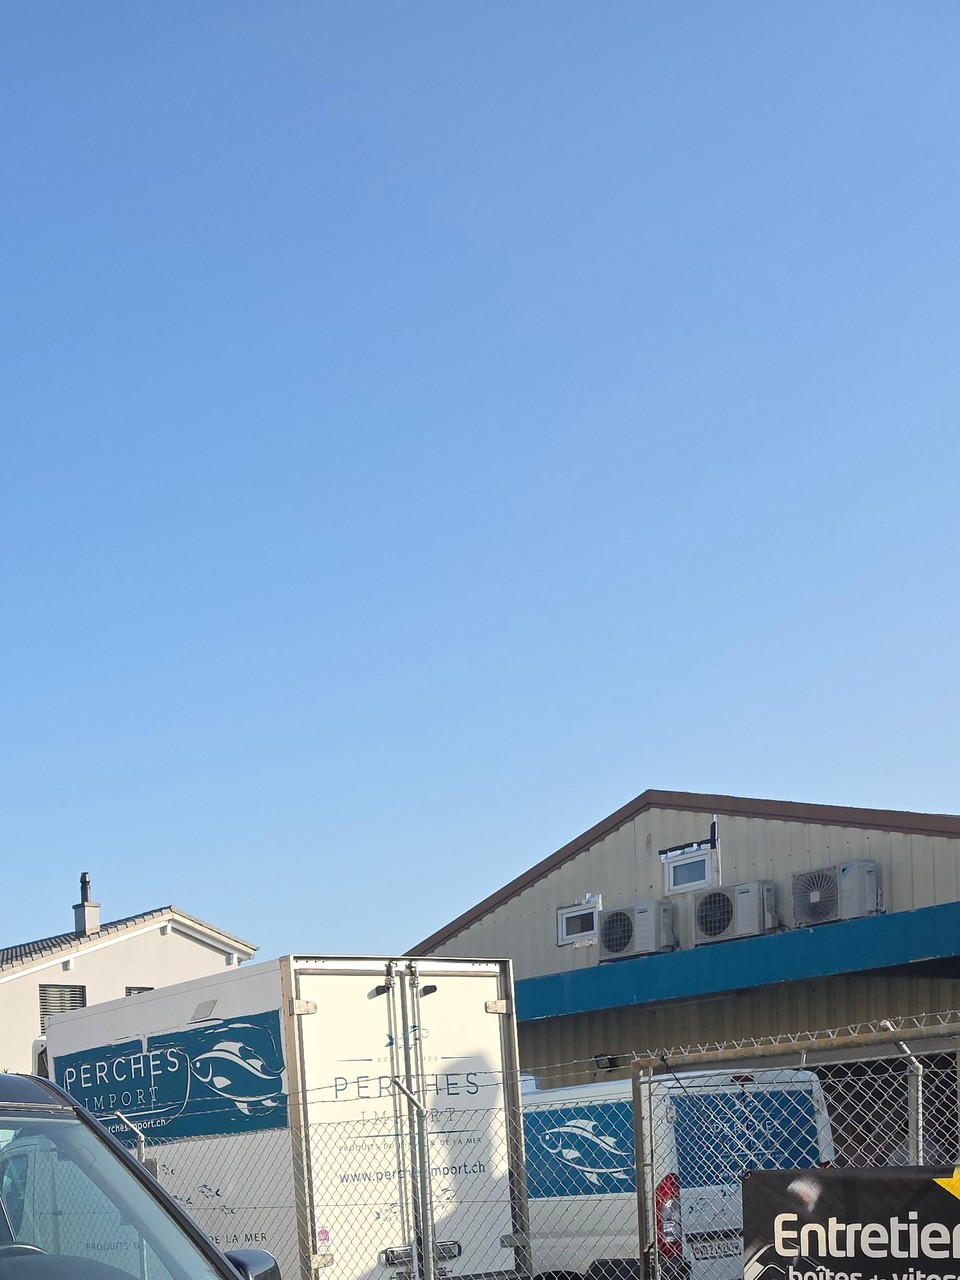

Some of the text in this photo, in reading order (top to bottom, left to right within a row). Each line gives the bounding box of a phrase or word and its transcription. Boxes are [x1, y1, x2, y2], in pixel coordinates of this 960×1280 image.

[65, 1049, 180, 1090] PERCHES
[84, 1086, 159, 1111] IMPORT
[361, 1107, 457, 1126] IMPRT
[466, 1136, 482, 1144] MER
[225, 1234, 239, 1244] LA
[244, 1232, 268, 1243] MER
[773, 1211, 960, 1260] Entretie
